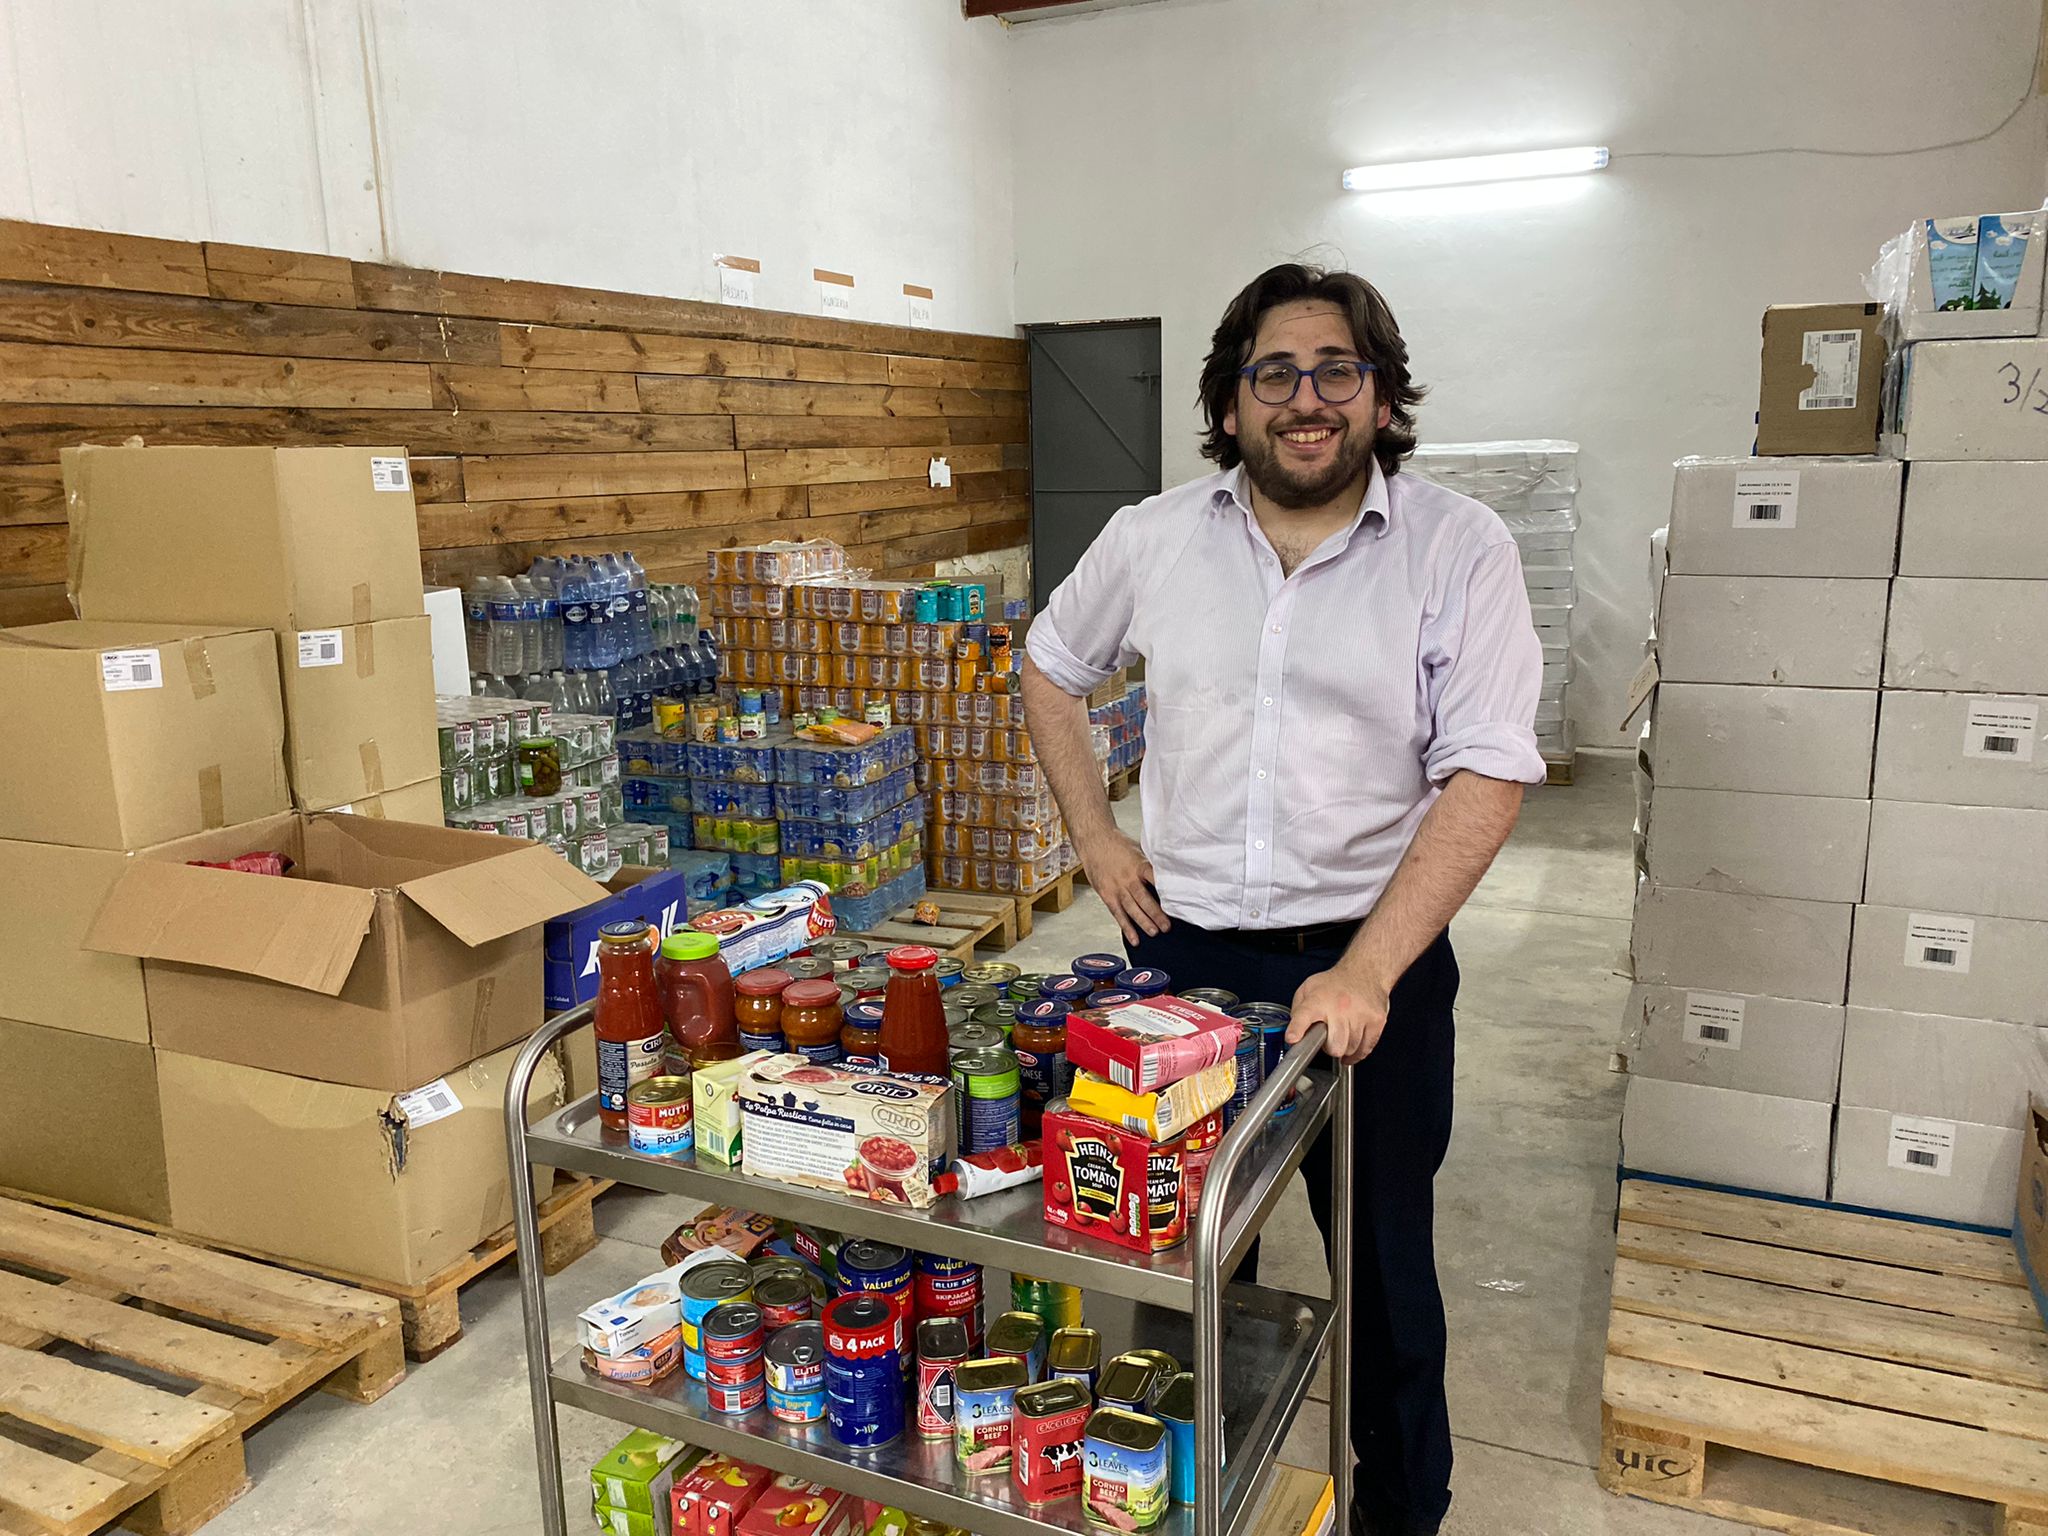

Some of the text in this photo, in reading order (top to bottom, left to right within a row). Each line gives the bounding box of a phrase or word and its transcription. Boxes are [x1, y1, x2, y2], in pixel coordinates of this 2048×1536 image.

[811, 910, 834, 928] MUTTI
[1149, 1009, 1181, 1024] TOMATO
[856, 1082, 913, 1099] CIRIO
[658, 1103, 689, 1118] MUTTI
[754, 1103, 777, 1117] Polpa
[777, 1107, 807, 1121] Rustica
[876, 1108, 921, 1132] CIRIO
[657, 1130, 691, 1145] POLPA
[1078, 1143, 1113, 1164] HEINZ
[1147, 1158, 1173, 1171] EINZ
[1074, 1165, 1118, 1189] TOMATO
[1147, 1181, 1178, 1197] MATO
[796, 1233, 820, 1259] ELITE
[934, 1261, 964, 1270] VALUE
[863, 1271, 911, 1290] VALUE PACK
[935, 1281, 959, 1290] BLUE
[936, 1291, 969, 1301] SKIPJACK
[846, 1335, 885, 1352] 4 PACK
[794, 1364, 820, 1376] ELITE
[972, 1403, 1013, 1419] 3 LEAVES
[976, 1424, 1009, 1435] CORNED
[1038, 1412, 1088, 1433] EXCELLENCE
[983, 1431, 1002, 1441] BEEF
[1089, 1451, 1098, 1468] 3
[1098, 1459, 1129, 1473] LEAVES
[1092, 1479, 1126, 1493] CORNED
[1099, 1488, 1118, 1498] BEEF
